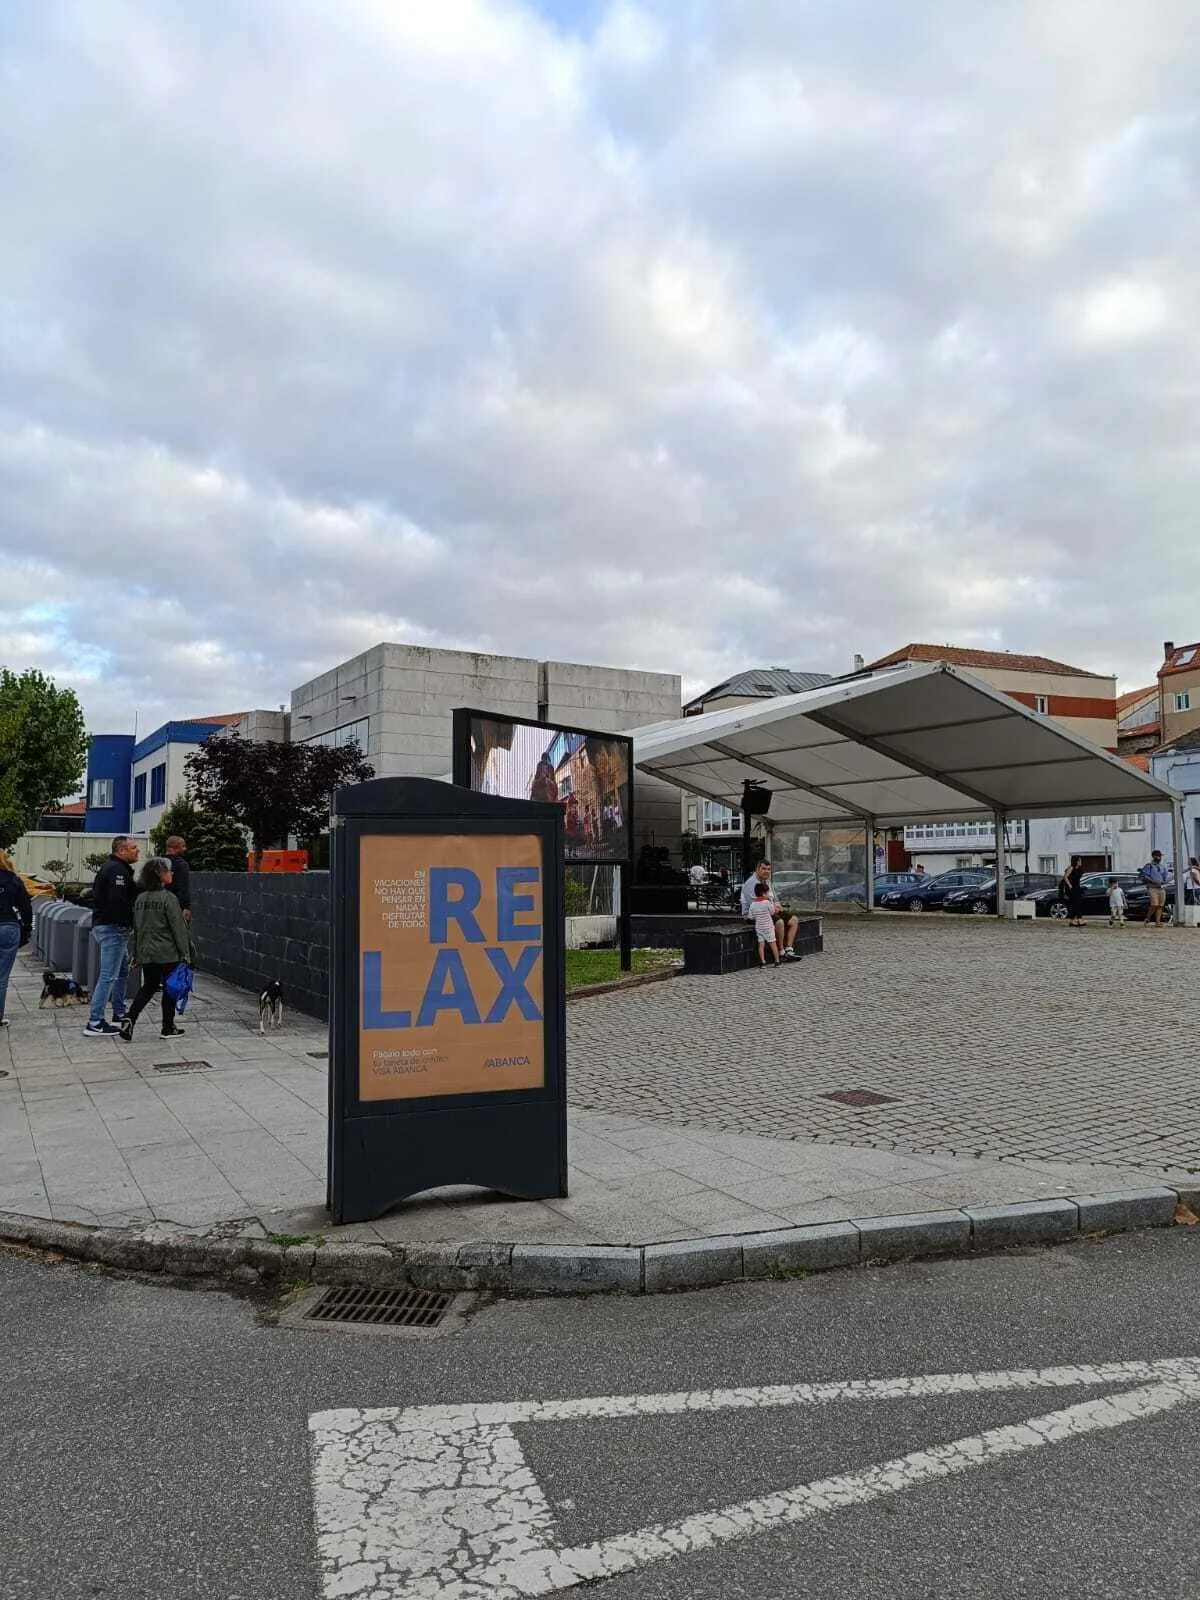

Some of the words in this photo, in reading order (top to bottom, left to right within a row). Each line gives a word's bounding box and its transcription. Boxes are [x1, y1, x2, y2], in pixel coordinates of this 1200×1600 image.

[391, 887, 406, 896] HAY
[429, 866, 542, 944] RE
[362, 946, 544, 1030] LAX
